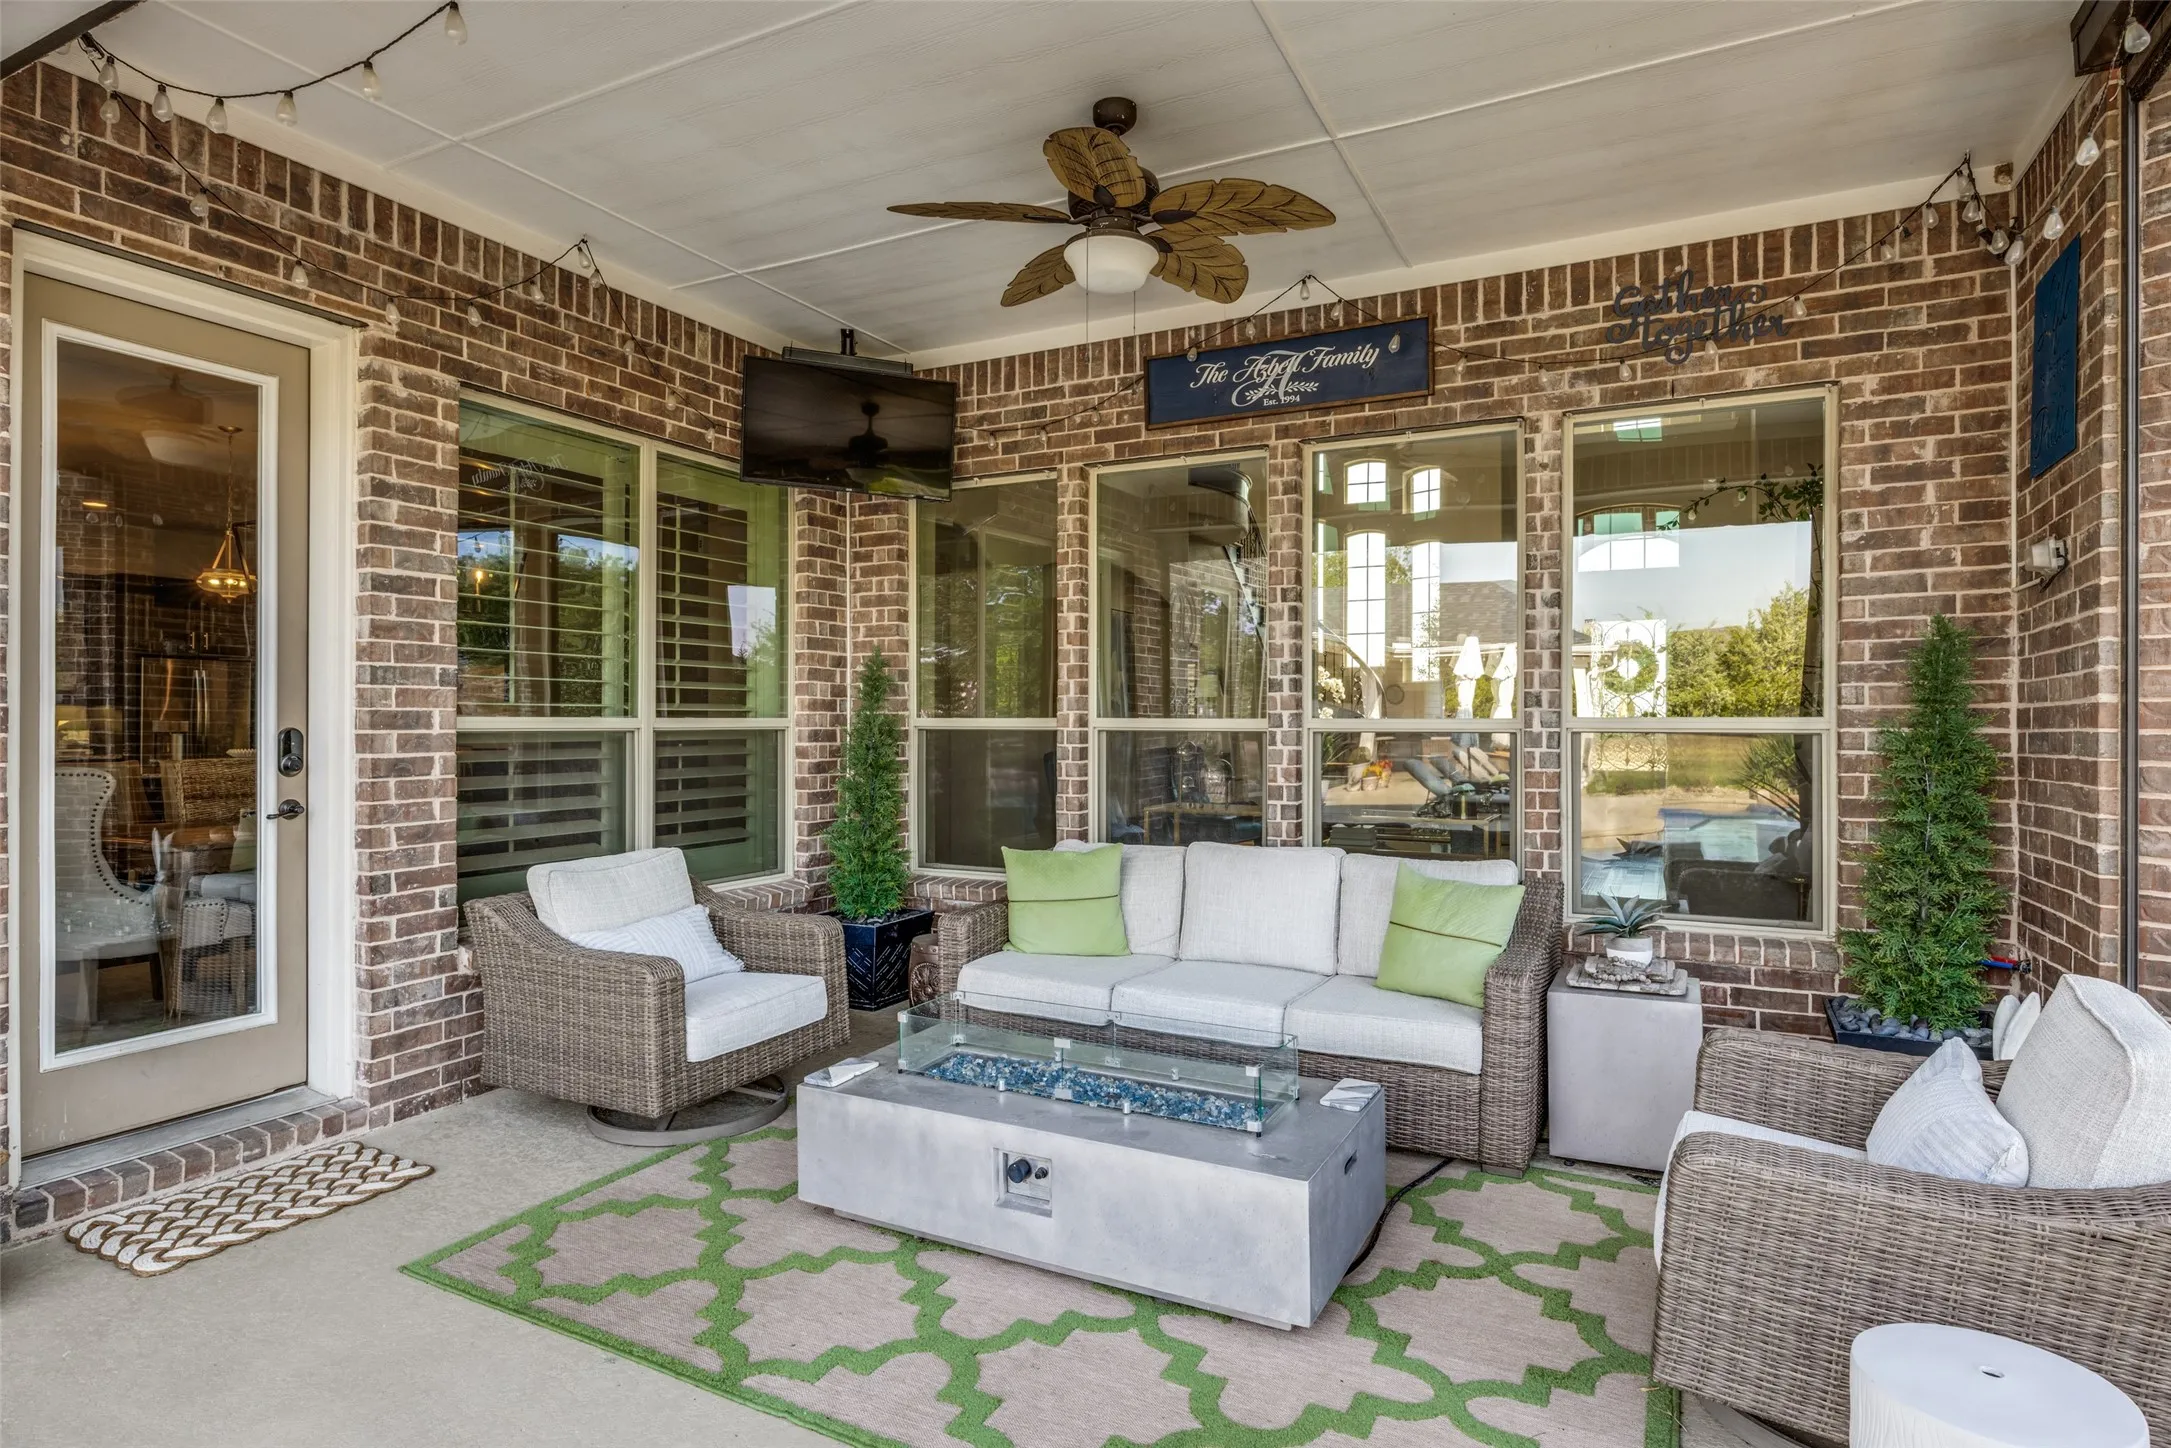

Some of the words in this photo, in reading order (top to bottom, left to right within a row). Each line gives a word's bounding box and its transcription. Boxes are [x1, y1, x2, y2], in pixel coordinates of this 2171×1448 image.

[1608, 268, 1767, 332] Gather
[1189, 361, 1229, 388] The
[1302, 342, 1380, 373] Family
[1263, 398, 1279, 406] Est.
[1280, 394, 1301, 404] 1994
